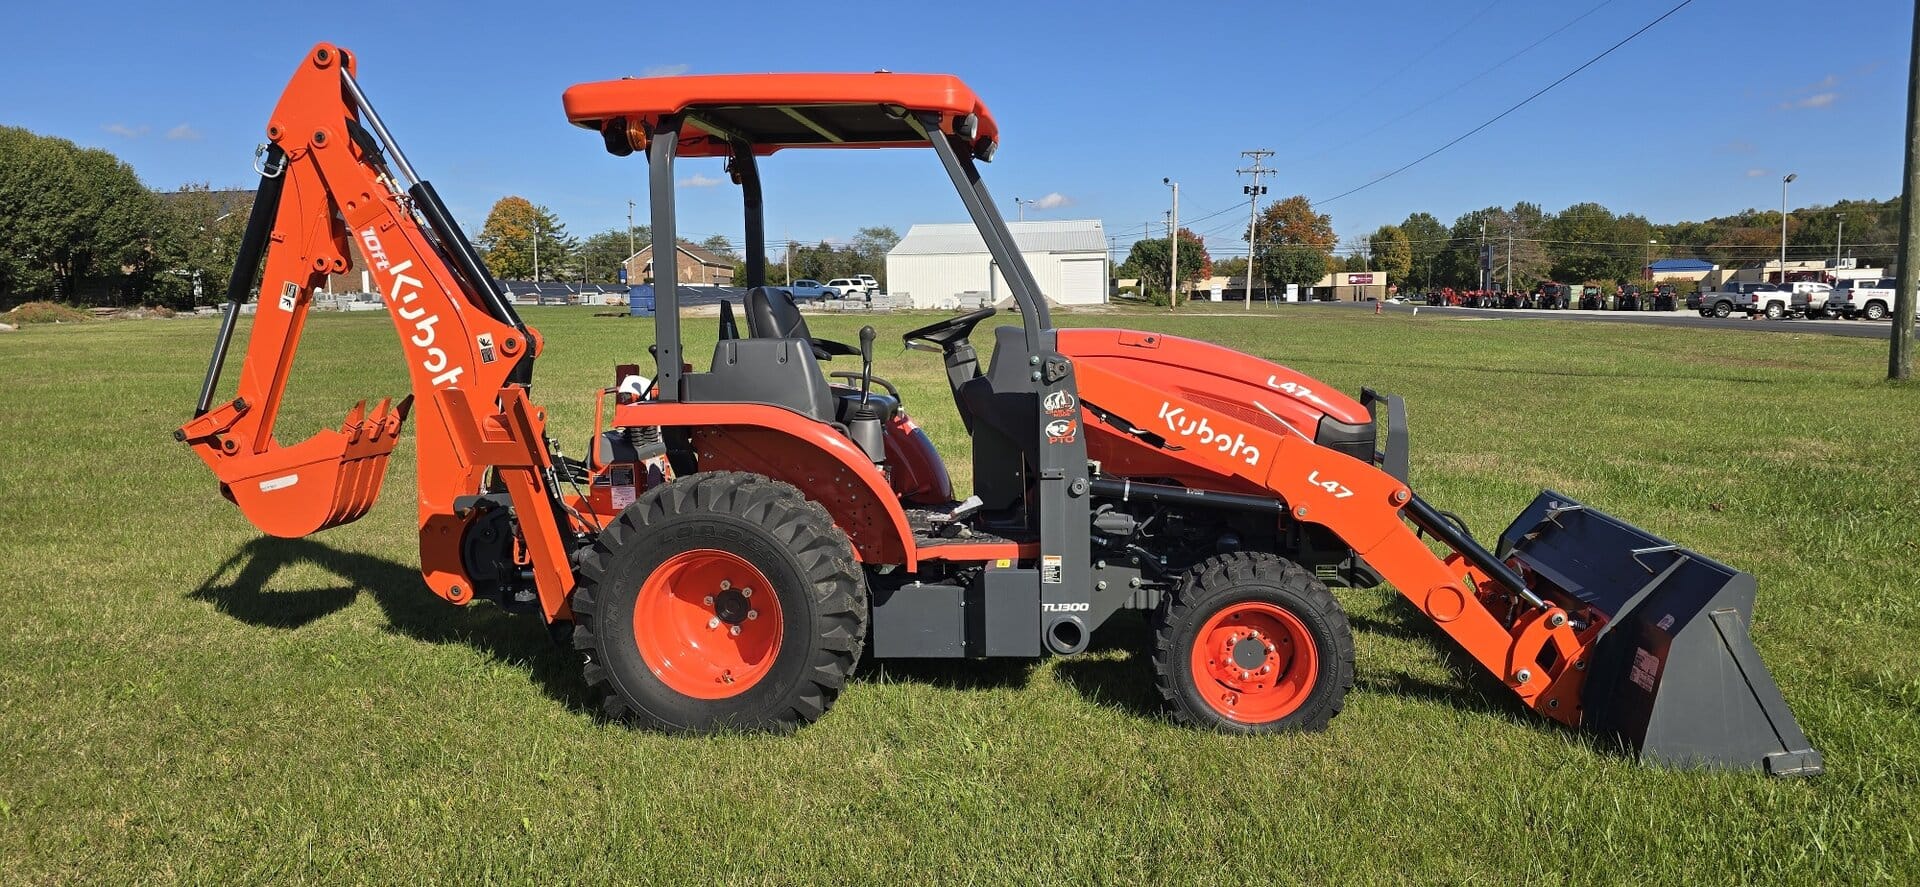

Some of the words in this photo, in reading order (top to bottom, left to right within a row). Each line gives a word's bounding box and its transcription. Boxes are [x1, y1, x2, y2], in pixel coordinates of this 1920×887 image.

[360, 226, 391, 271] 10ft
[389, 260, 464, 389] Kubot
[1267, 374, 1314, 398] L47
[1048, 436, 1075, 444] PTO
[1158, 401, 1261, 466] Kubota
[1307, 470, 1354, 499] L47
[1042, 603, 1089, 612] TL1300
